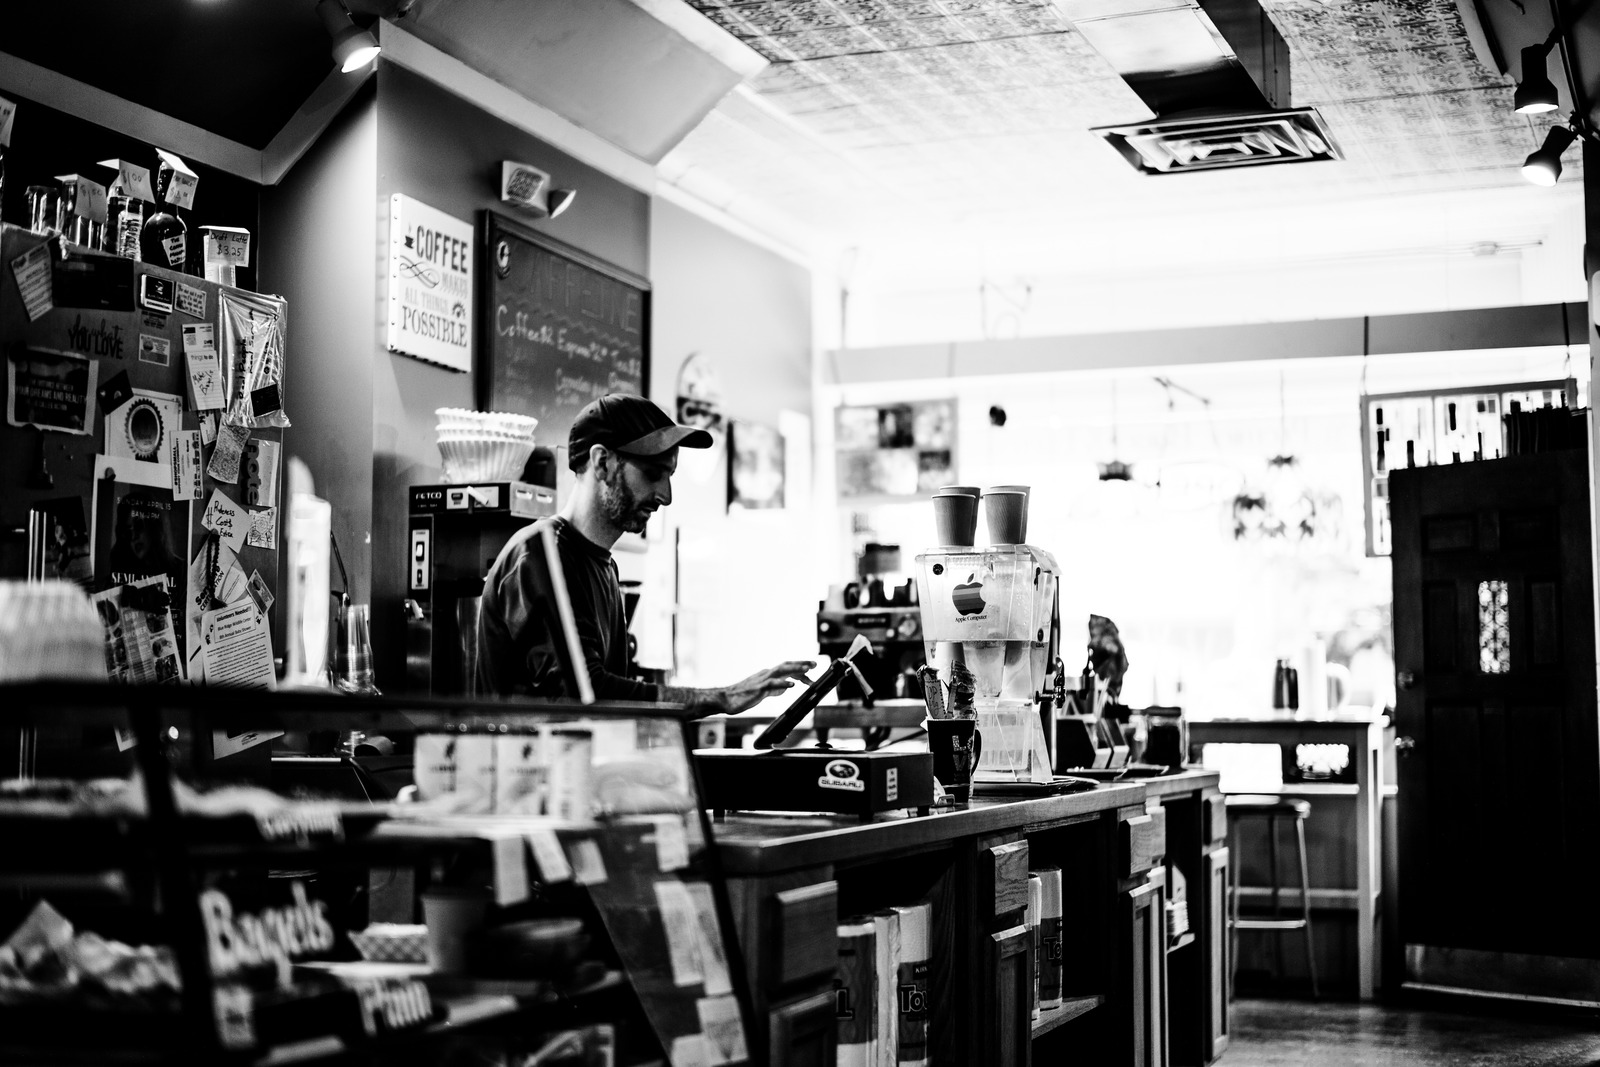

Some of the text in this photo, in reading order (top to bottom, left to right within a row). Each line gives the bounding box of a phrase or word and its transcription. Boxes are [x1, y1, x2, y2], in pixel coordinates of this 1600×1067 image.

[210, 232, 248, 244] Draft Latte
[217, 243, 243, 257] $3.25
[416, 225, 468, 274] COFFEE
[402, 305, 468, 348] POSSIBLE
[94, 334, 123, 360] LOVE
[955, 614, 988, 623] Apple Computer
